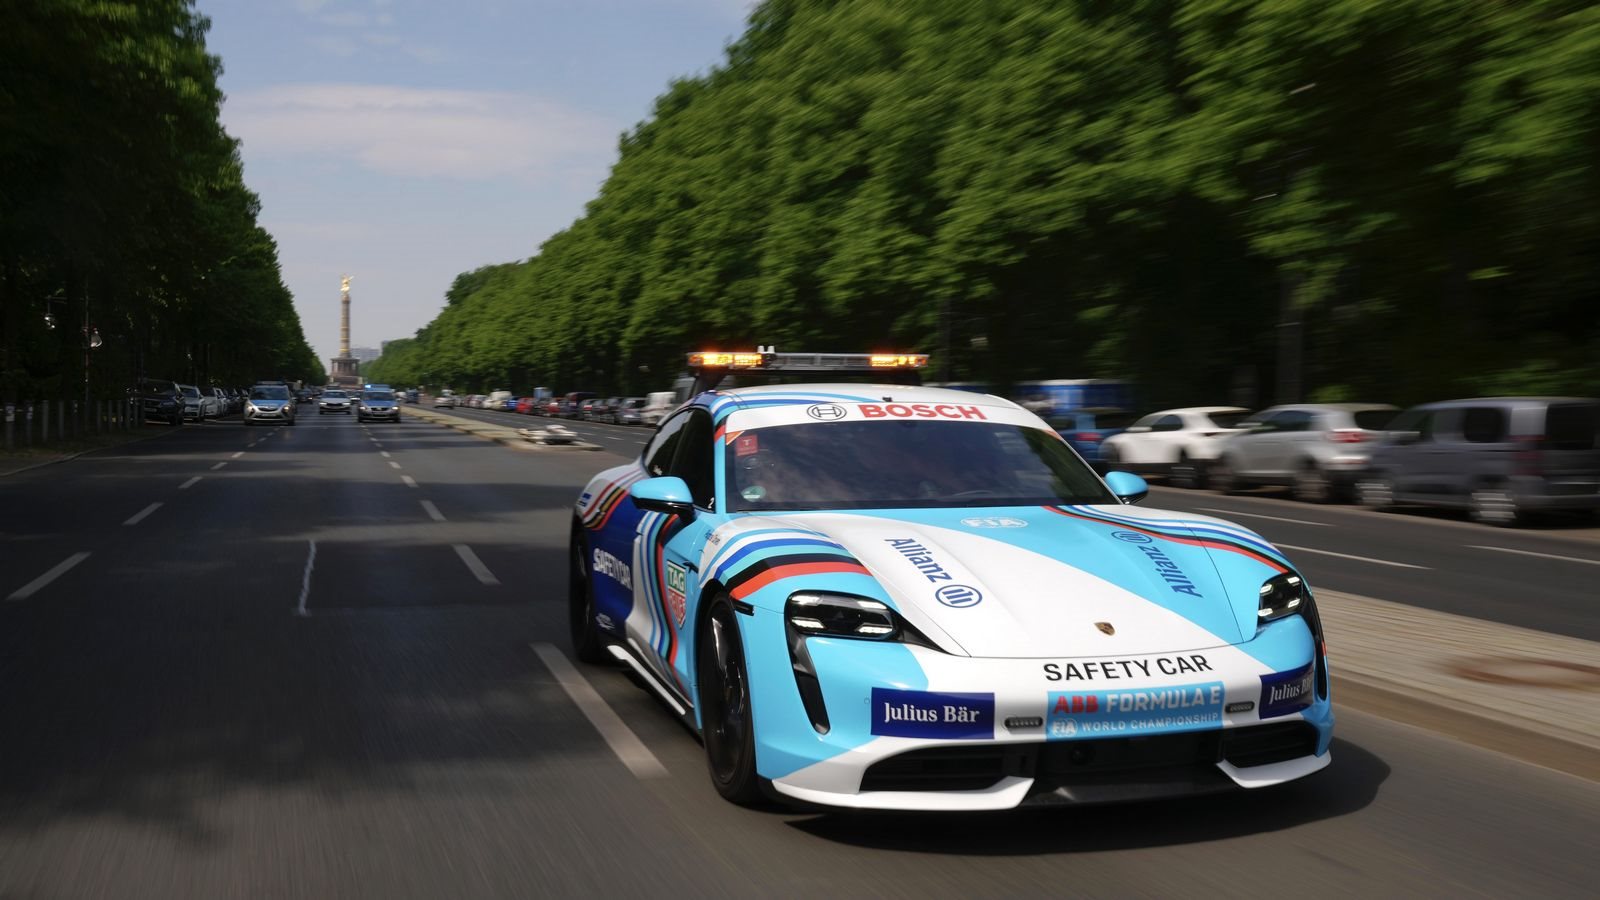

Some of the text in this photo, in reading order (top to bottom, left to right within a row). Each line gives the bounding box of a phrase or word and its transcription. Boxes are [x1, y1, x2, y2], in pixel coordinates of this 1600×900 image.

[857, 404, 987, 420] BOSCH
[885, 538, 953, 583] Allianz
[1137, 545, 1204, 599] Allianz
[668, 566, 685, 592] TAG
[1043, 655, 1213, 681] SAFETY CAR
[1053, 686, 1221, 715] ABB FORMULA E
[1269, 684, 1300, 705] Julius
[884, 702, 980, 723] Julius Bär
[1082, 714, 1219, 732] WORLD CHAMPIONSHIP
[1052, 720, 1076, 735] FIA
